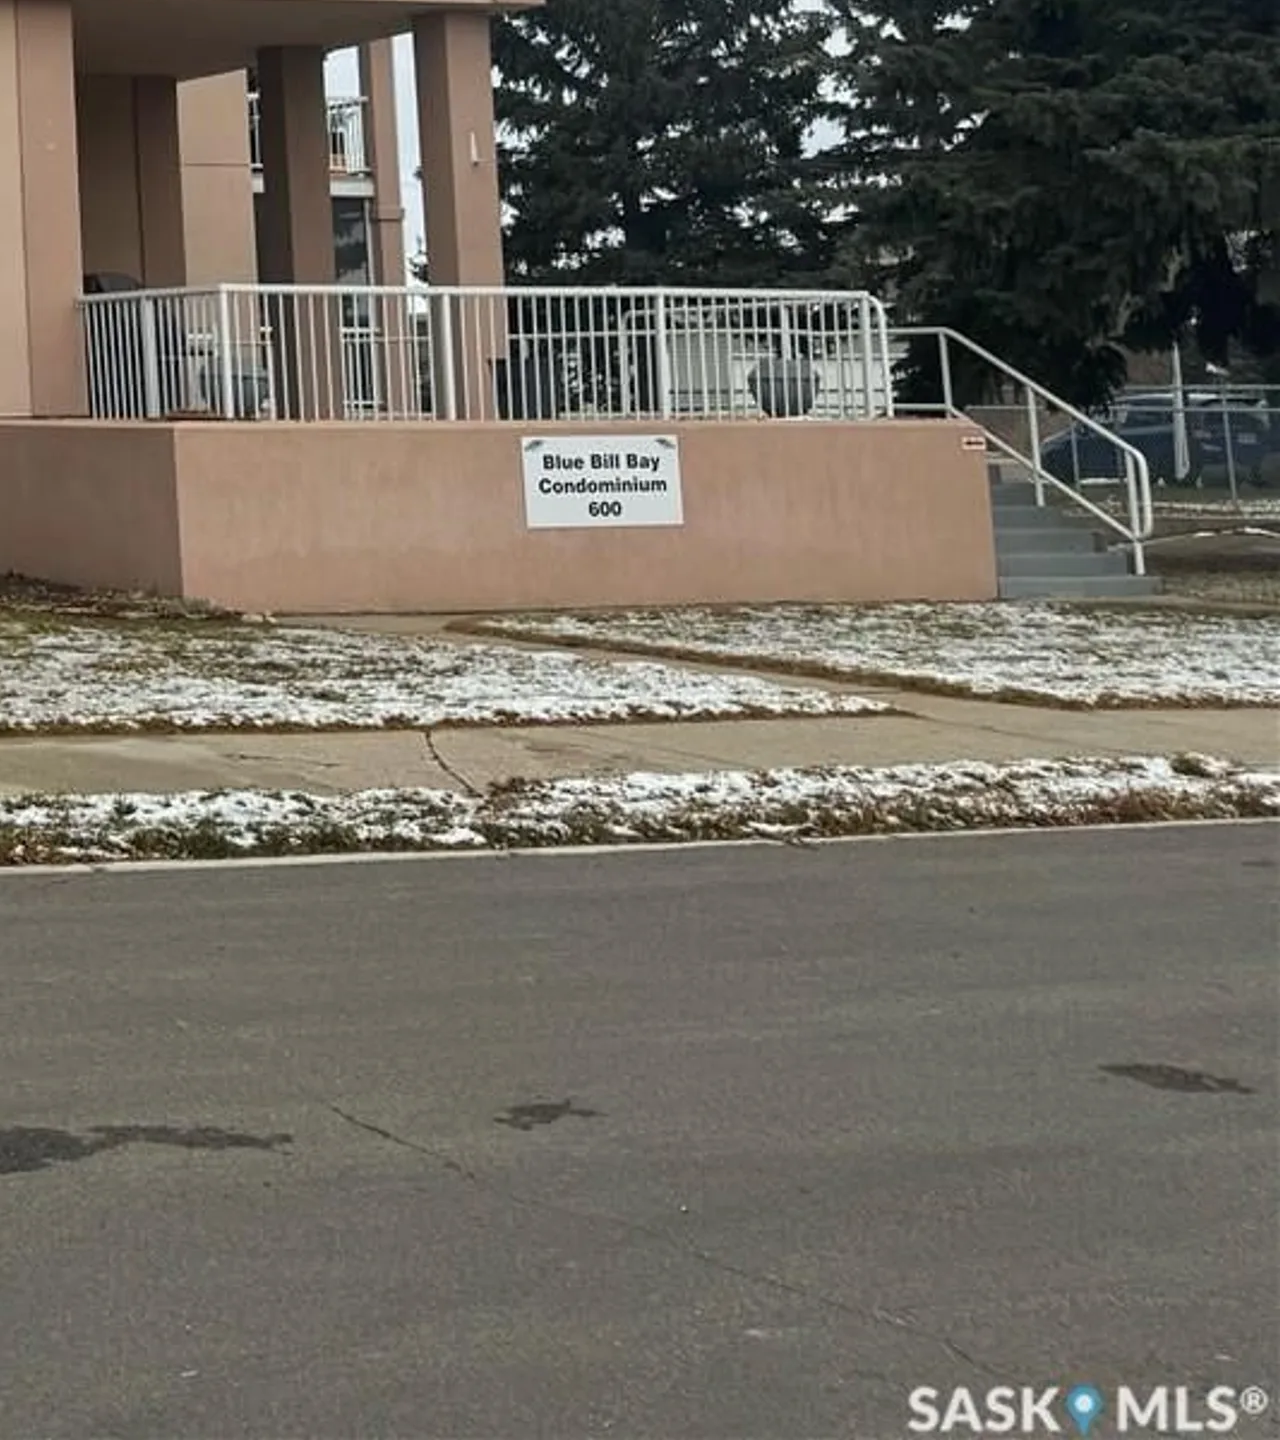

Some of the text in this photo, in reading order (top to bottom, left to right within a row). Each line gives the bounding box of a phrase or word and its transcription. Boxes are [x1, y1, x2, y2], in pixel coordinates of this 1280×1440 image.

[542, 453, 660, 472] Blue Bill Bay
[538, 477, 667, 494] Condominium
[588, 501, 622, 517] 600
